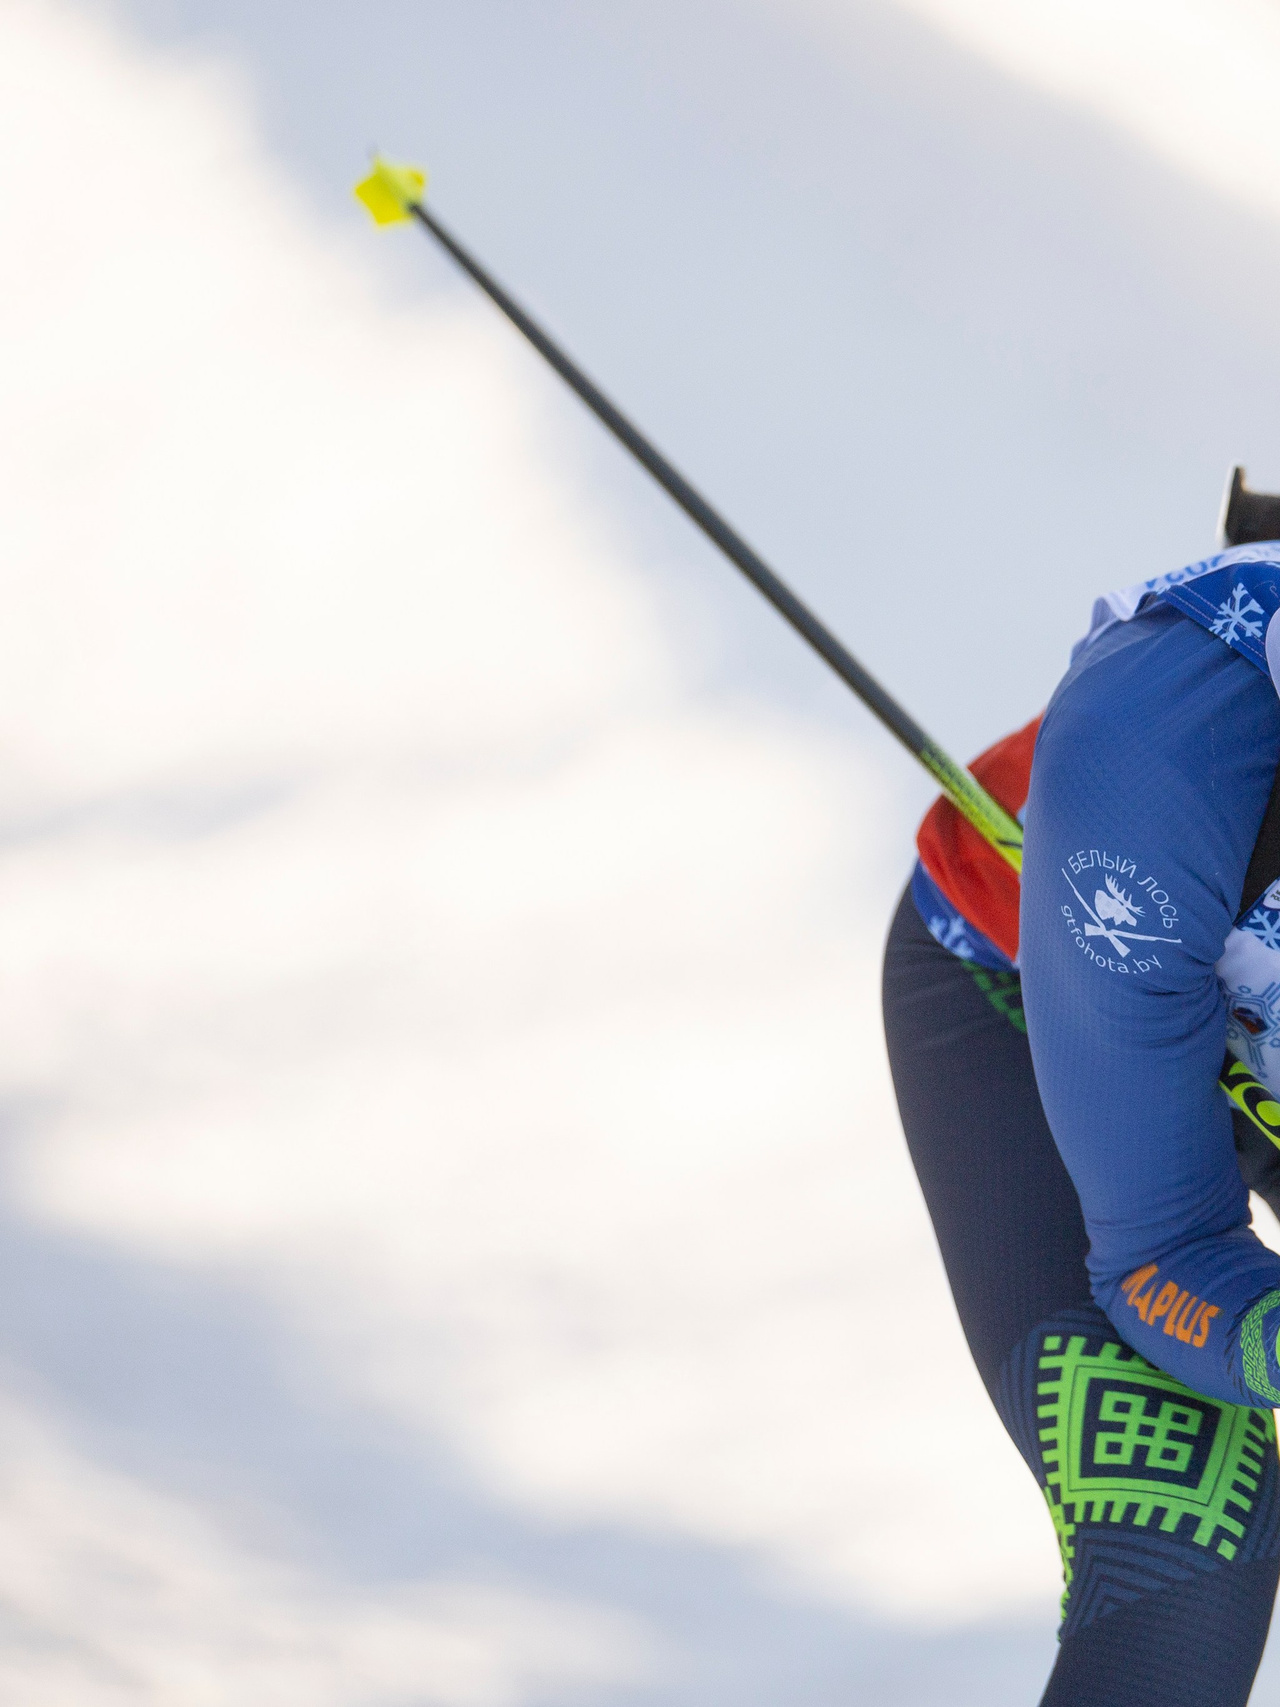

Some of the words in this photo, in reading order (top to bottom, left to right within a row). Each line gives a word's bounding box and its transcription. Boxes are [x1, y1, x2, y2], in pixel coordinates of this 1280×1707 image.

[1068, 850, 1137, 878] БЕЛЫЙ
[1137, 876, 1179, 929] ЛОСЬ
[1060, 904, 1162, 974] gtfohota.by
